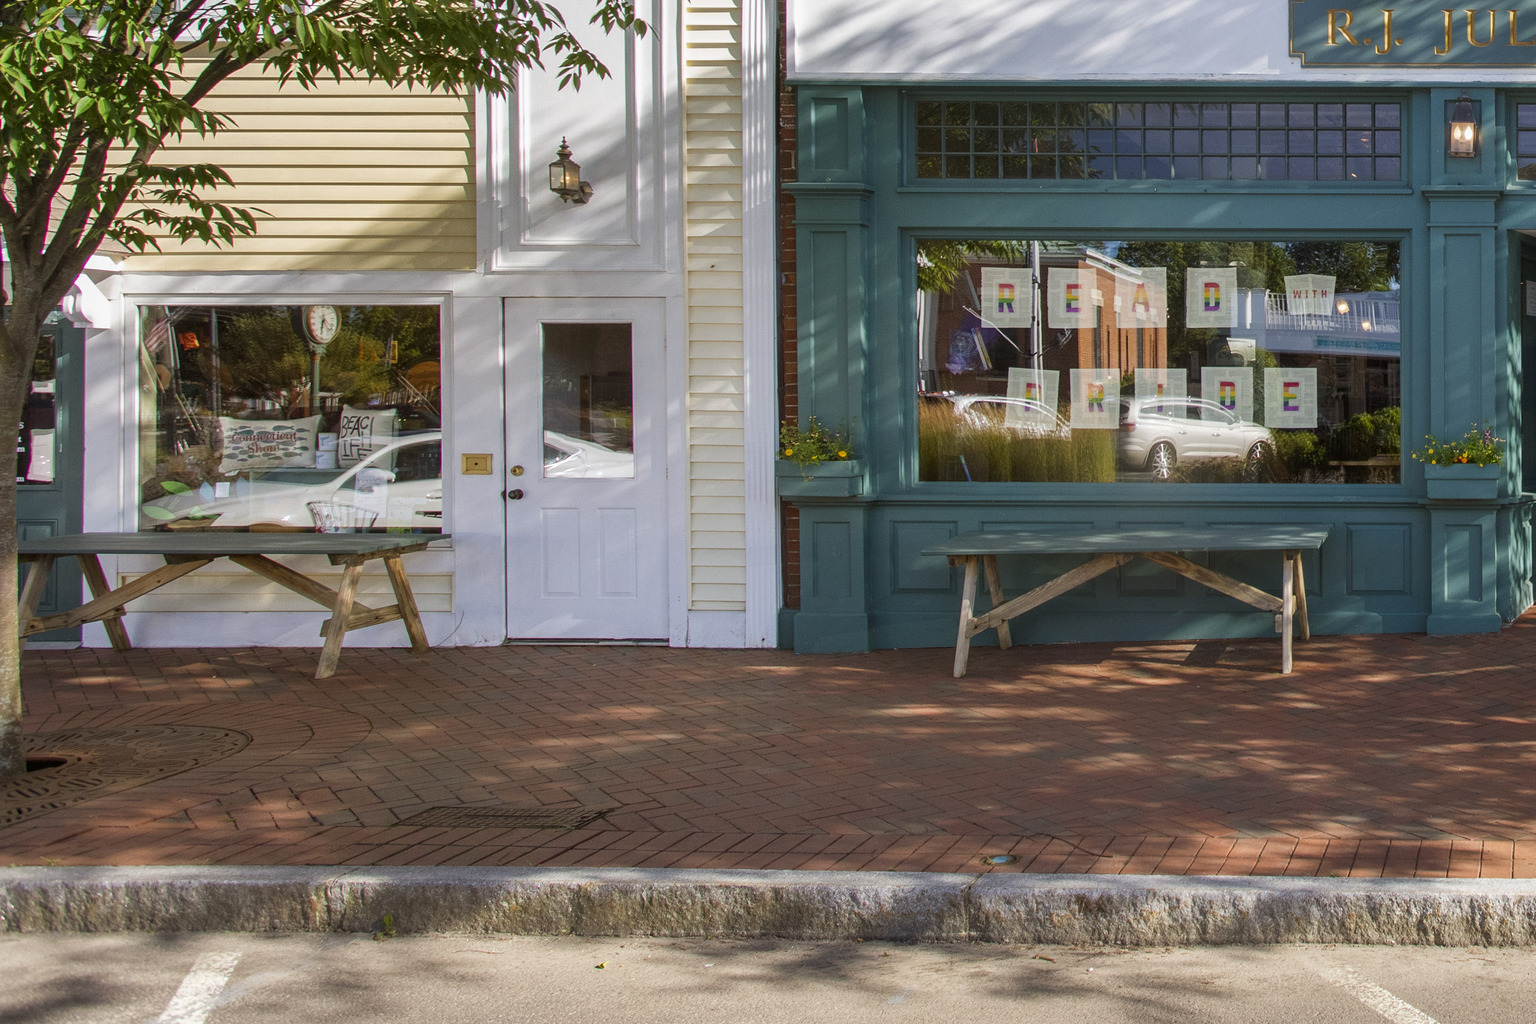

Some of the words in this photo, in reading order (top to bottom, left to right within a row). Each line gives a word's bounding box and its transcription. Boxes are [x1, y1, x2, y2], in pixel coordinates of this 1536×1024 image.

[1324, 8, 1404, 55] R.J.
[998, 282, 1220, 314] READ
[1293, 289, 1328, 299] WITH
[1024, 381, 1299, 412] PRIDE
[231, 431, 297, 443] Connecticut
[247, 443, 280, 453] Shore
